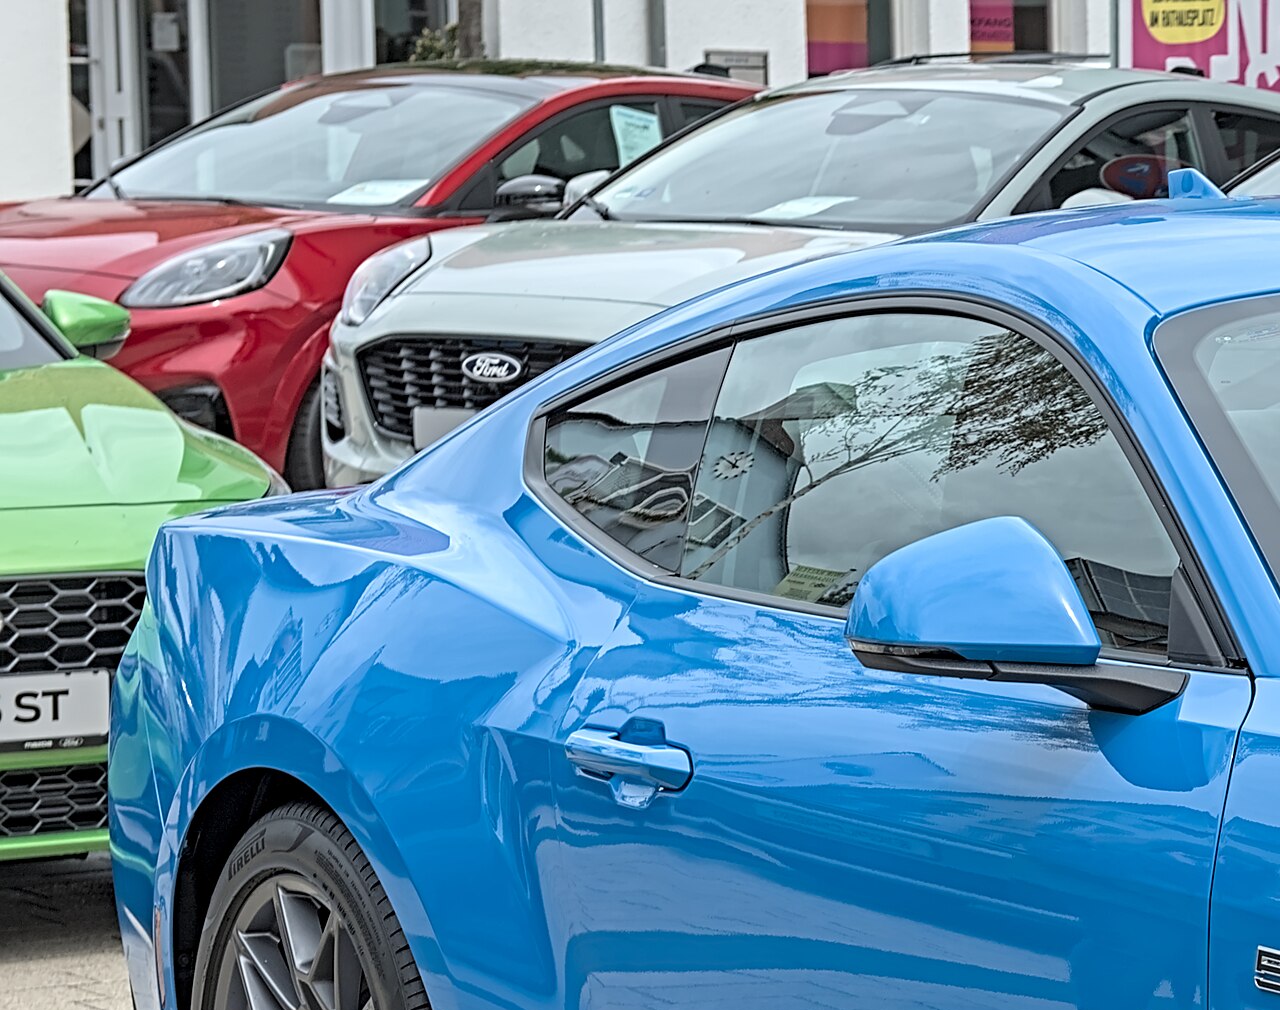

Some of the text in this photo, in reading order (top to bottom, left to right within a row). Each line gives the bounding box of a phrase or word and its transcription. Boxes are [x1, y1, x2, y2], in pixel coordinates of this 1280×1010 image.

[472, 356, 510, 378] Ford
[13, 688, 70, 723] ST
[228, 828, 266, 881] PIRELLI
